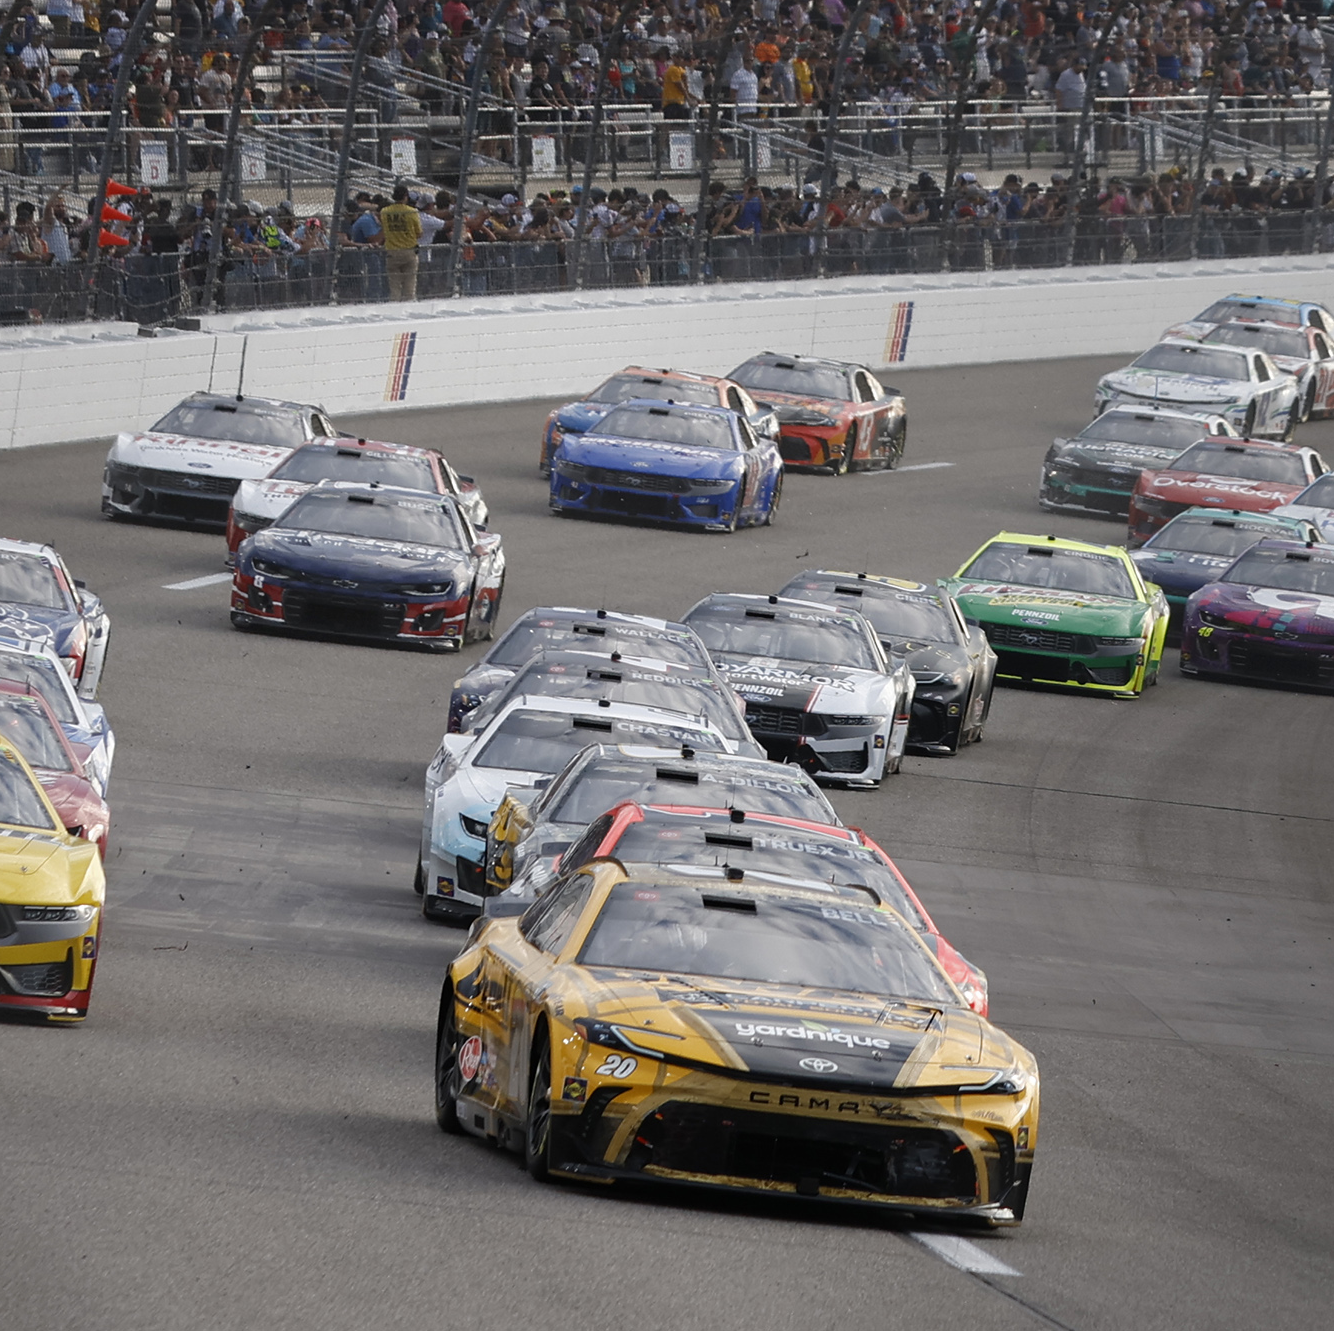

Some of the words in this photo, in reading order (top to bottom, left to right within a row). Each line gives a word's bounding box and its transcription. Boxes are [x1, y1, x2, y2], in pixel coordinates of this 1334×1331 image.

[1153, 475, 1289, 504] Overstock
[397, 501, 443, 513] BUSCH
[895, 593, 938, 606] GIBBS
[789, 612, 842, 626] BLANEY
[1012, 608, 1060, 622] PENNZOIL
[1197, 626, 1214, 638] 48
[632, 672, 701, 687] REDDICK
[715, 661, 855, 692] DYARMOR
[617, 722, 716, 744] CHASTAIN
[701, 772, 723, 784] A.
[729, 776, 808, 796] DILLON
[755, 836, 835, 857] TRUEX
[821, 906, 888, 927] BELL
[735, 1021, 891, 1050] yardnique
[595, 1053, 639, 1080] 20
[749, 1090, 897, 1116] CAMRY
